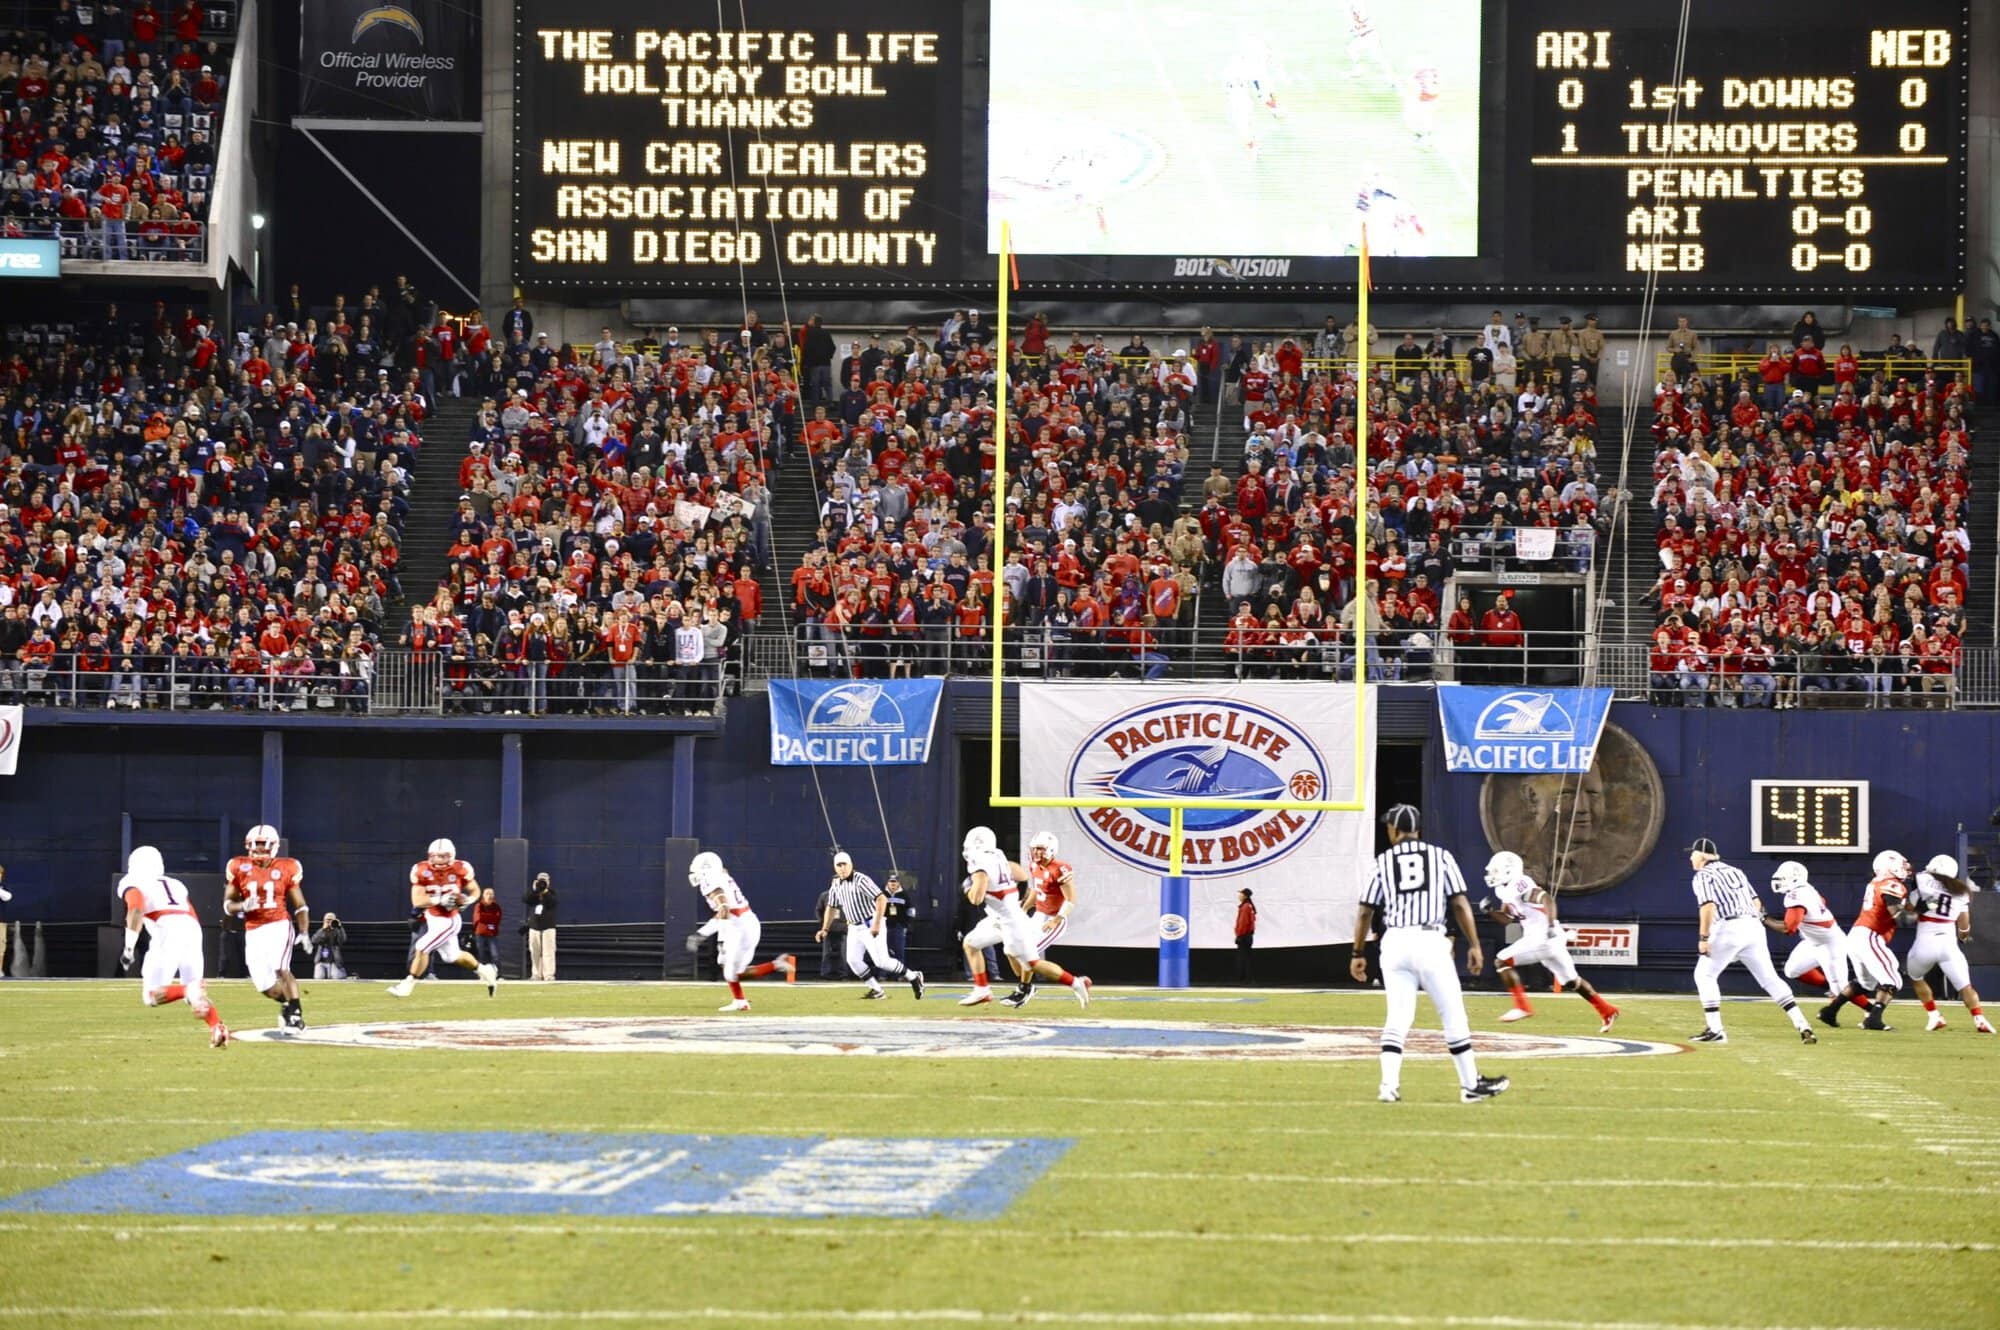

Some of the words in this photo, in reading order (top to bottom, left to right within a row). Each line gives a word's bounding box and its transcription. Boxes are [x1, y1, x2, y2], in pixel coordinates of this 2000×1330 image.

[320, 51, 381, 68] Official
[385, 53, 455, 70] Wireless
[537, 31, 613, 63] THE
[635, 31, 814, 63] PACIFIC
[836, 32, 940, 63] LIFE
[1536, 31, 1611, 68] ARI
[1870, 30, 1951, 68] NEB
[355, 71, 427, 88] Provider
[583, 64, 763, 95] HOLIDAY
[785, 65, 887, 95] BOWL
[1558, 79, 1584, 108] 0
[1629, 79, 1704, 108] 1st
[1723, 79, 1855, 108] DOWNS
[1900, 78, 1927, 107] 0
[661, 98, 813, 128] THANKS
[1561, 123, 1579, 153] 1
[1621, 123, 1858, 153] TURNOVERS
[1900, 123, 1926, 152] 0
[542, 141, 619, 174] NEW
[645, 142, 722, 175] CAR
[748, 142, 927, 176] DEALERS
[1627, 168, 1864, 198] PENALTIES
[557, 185, 838, 221] ASSOCIATION
[864, 188, 915, 221] OF
[1627, 205, 1701, 235] ARI
[1792, 205, 1871, 235] 0-0
[531, 229, 607, 262] SAN
[633, 230, 761, 264] DIEGO
[787, 231, 937, 264] COUNTY
[1626, 243, 1705, 272] NEB
[1792, 243, 1871, 272] 0-0
[773, 733, 878, 762] PACIFIC
[1104, 713, 1222, 761] PACIFIC
[1221, 711, 1291, 762] LIFE
[1447, 741, 1547, 770] PACIFIC
[1770, 787, 1850, 845] 40
[1221, 808, 1306, 864] BOWL
[1397, 852, 1425, 890] B
[158, 878, 180, 905] 1
[245, 880, 278, 908] 11
